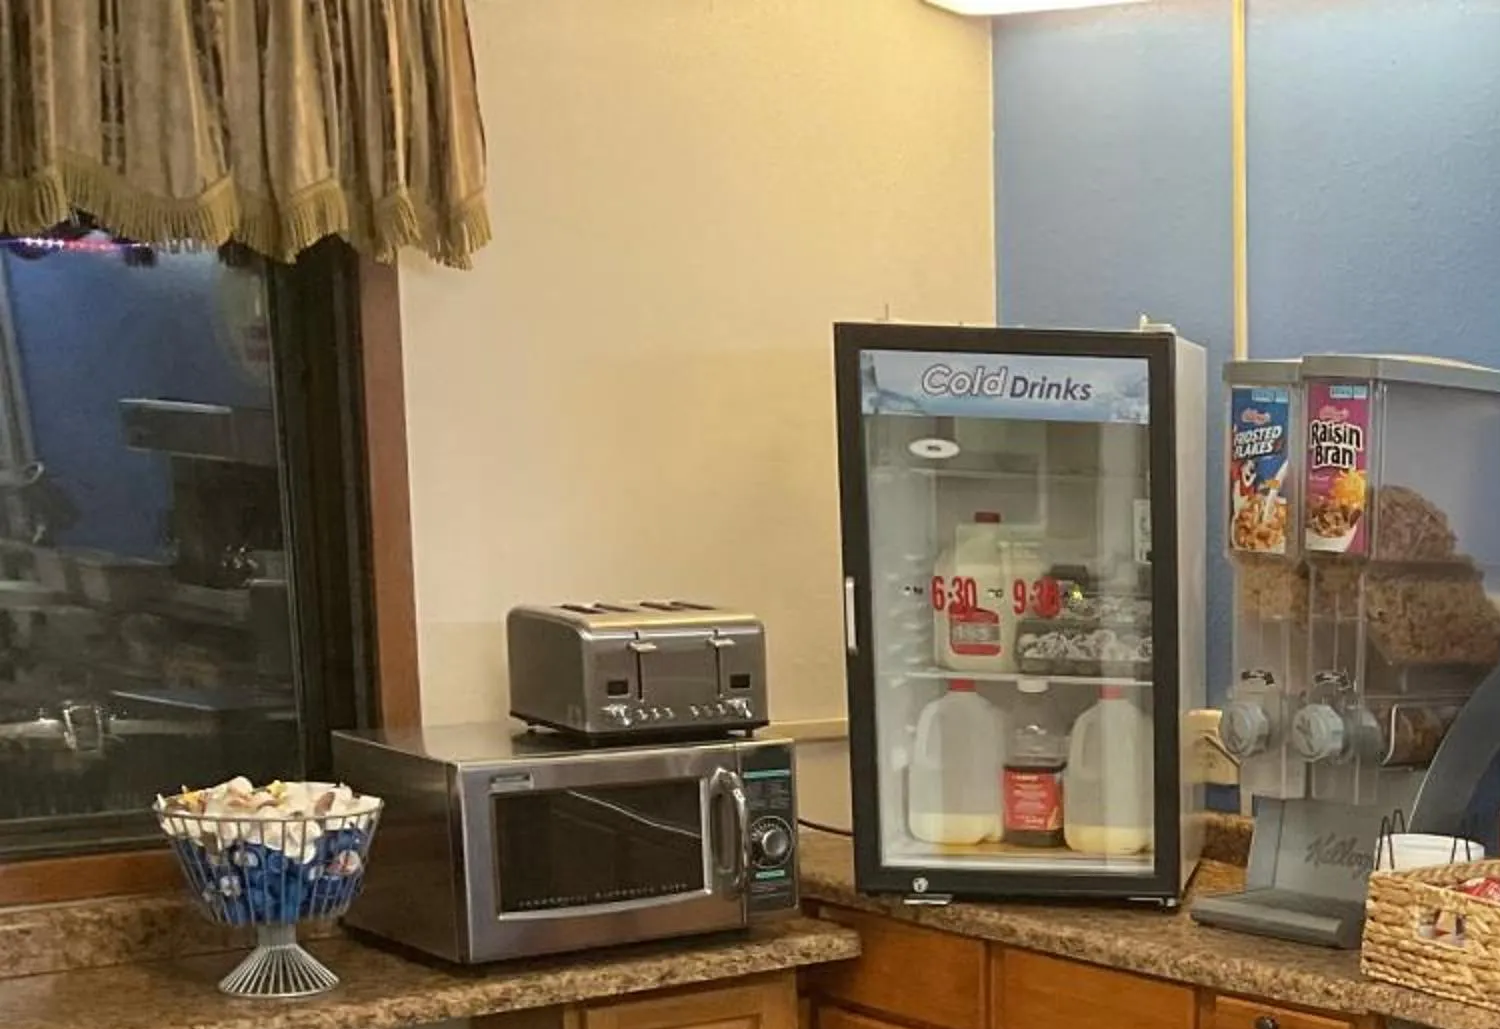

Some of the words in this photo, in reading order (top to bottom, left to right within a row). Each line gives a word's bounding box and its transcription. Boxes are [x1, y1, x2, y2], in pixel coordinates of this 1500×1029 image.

[921, 363, 1009, 396] Cold
[1010, 375, 1092, 401] Drinks
[1310, 421, 1363, 449] Raisin
[1314, 445, 1355, 467] Bran
